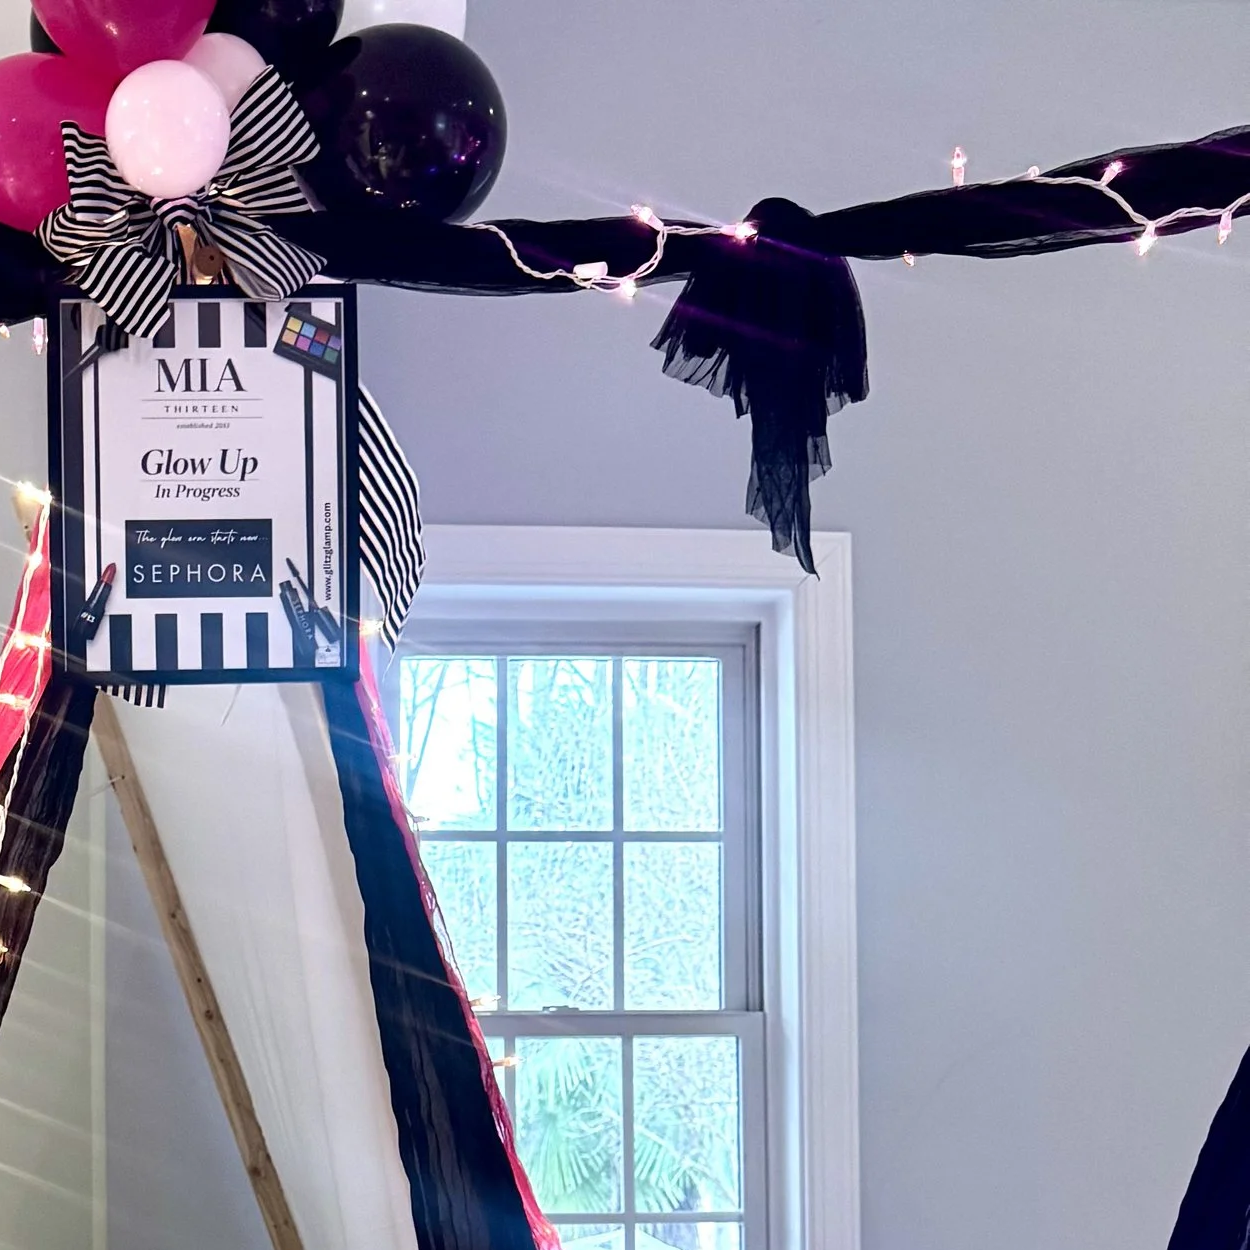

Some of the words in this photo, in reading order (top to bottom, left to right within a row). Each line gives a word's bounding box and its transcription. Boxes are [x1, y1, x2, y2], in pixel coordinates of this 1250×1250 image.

[153, 357, 248, 393] MIA
[163, 404, 239, 414] THIRTEEN
[140, 448, 212, 476] Glow
[219, 448, 258, 482] Up
[154, 484, 171, 499] In
[175, 484, 241, 502] Progress
[135, 529, 157, 544] The
[160, 527, 183, 549] glow
[209, 529, 238, 545] starts
[323, 502, 334, 602] www.glitzglamp.com
[132, 563, 267, 584] SEPHORA
[293, 599, 314, 641] SEPHORA
